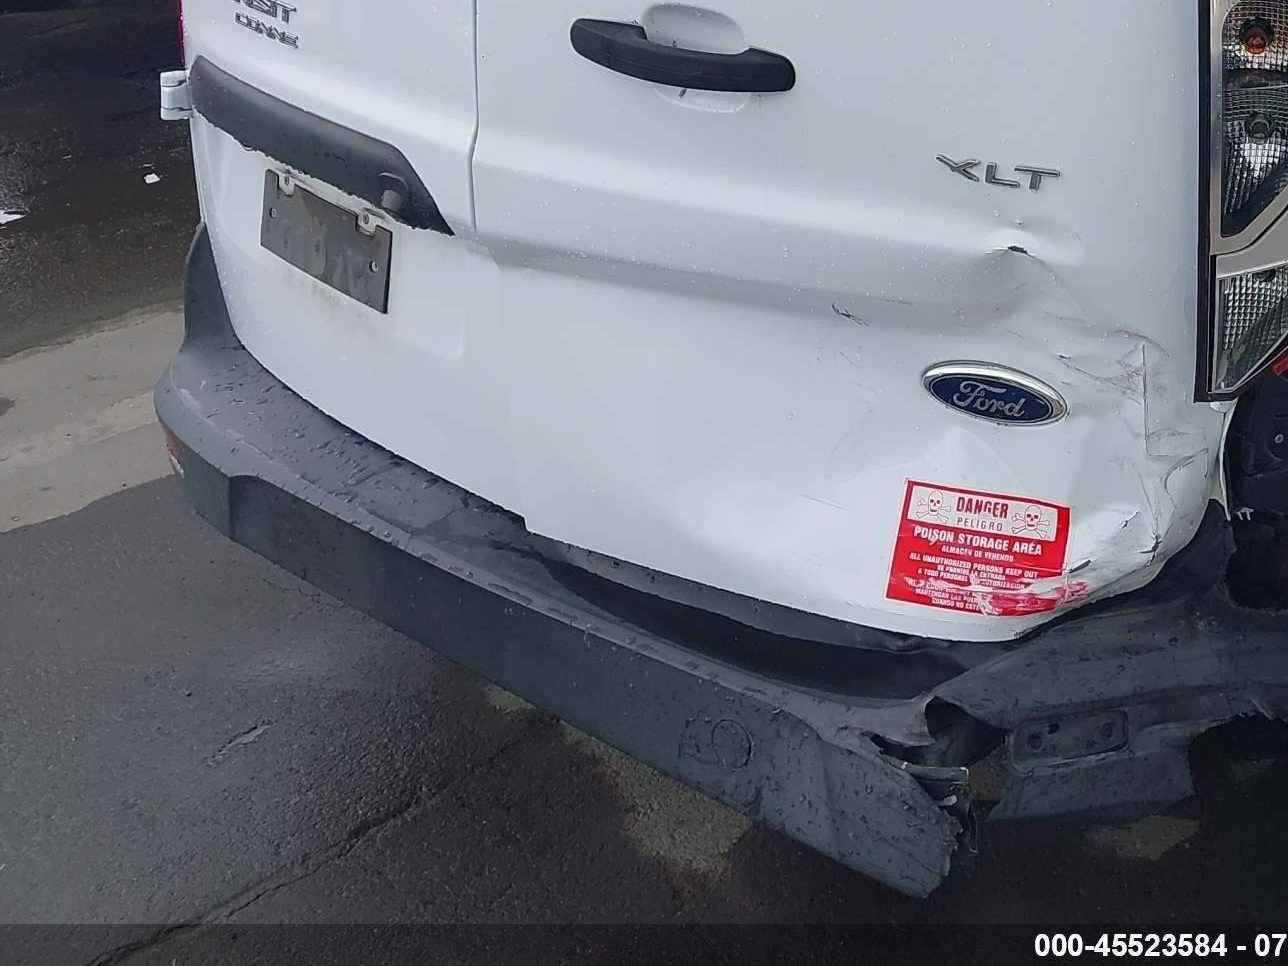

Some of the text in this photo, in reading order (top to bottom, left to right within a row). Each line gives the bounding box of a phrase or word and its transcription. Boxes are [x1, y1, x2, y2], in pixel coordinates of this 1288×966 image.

[935, 154, 1061, 193] XLT
[953, 380, 1027, 418] Ford
[955, 496, 1009, 520] DANGER
[956, 516, 1004, 532] PELIGRO
[913, 525, 1043, 556] POISON STORAGE AREA
[909, 552, 1039, 579] ALL UNAUTHORIZED PERSONS KEEP OUT
